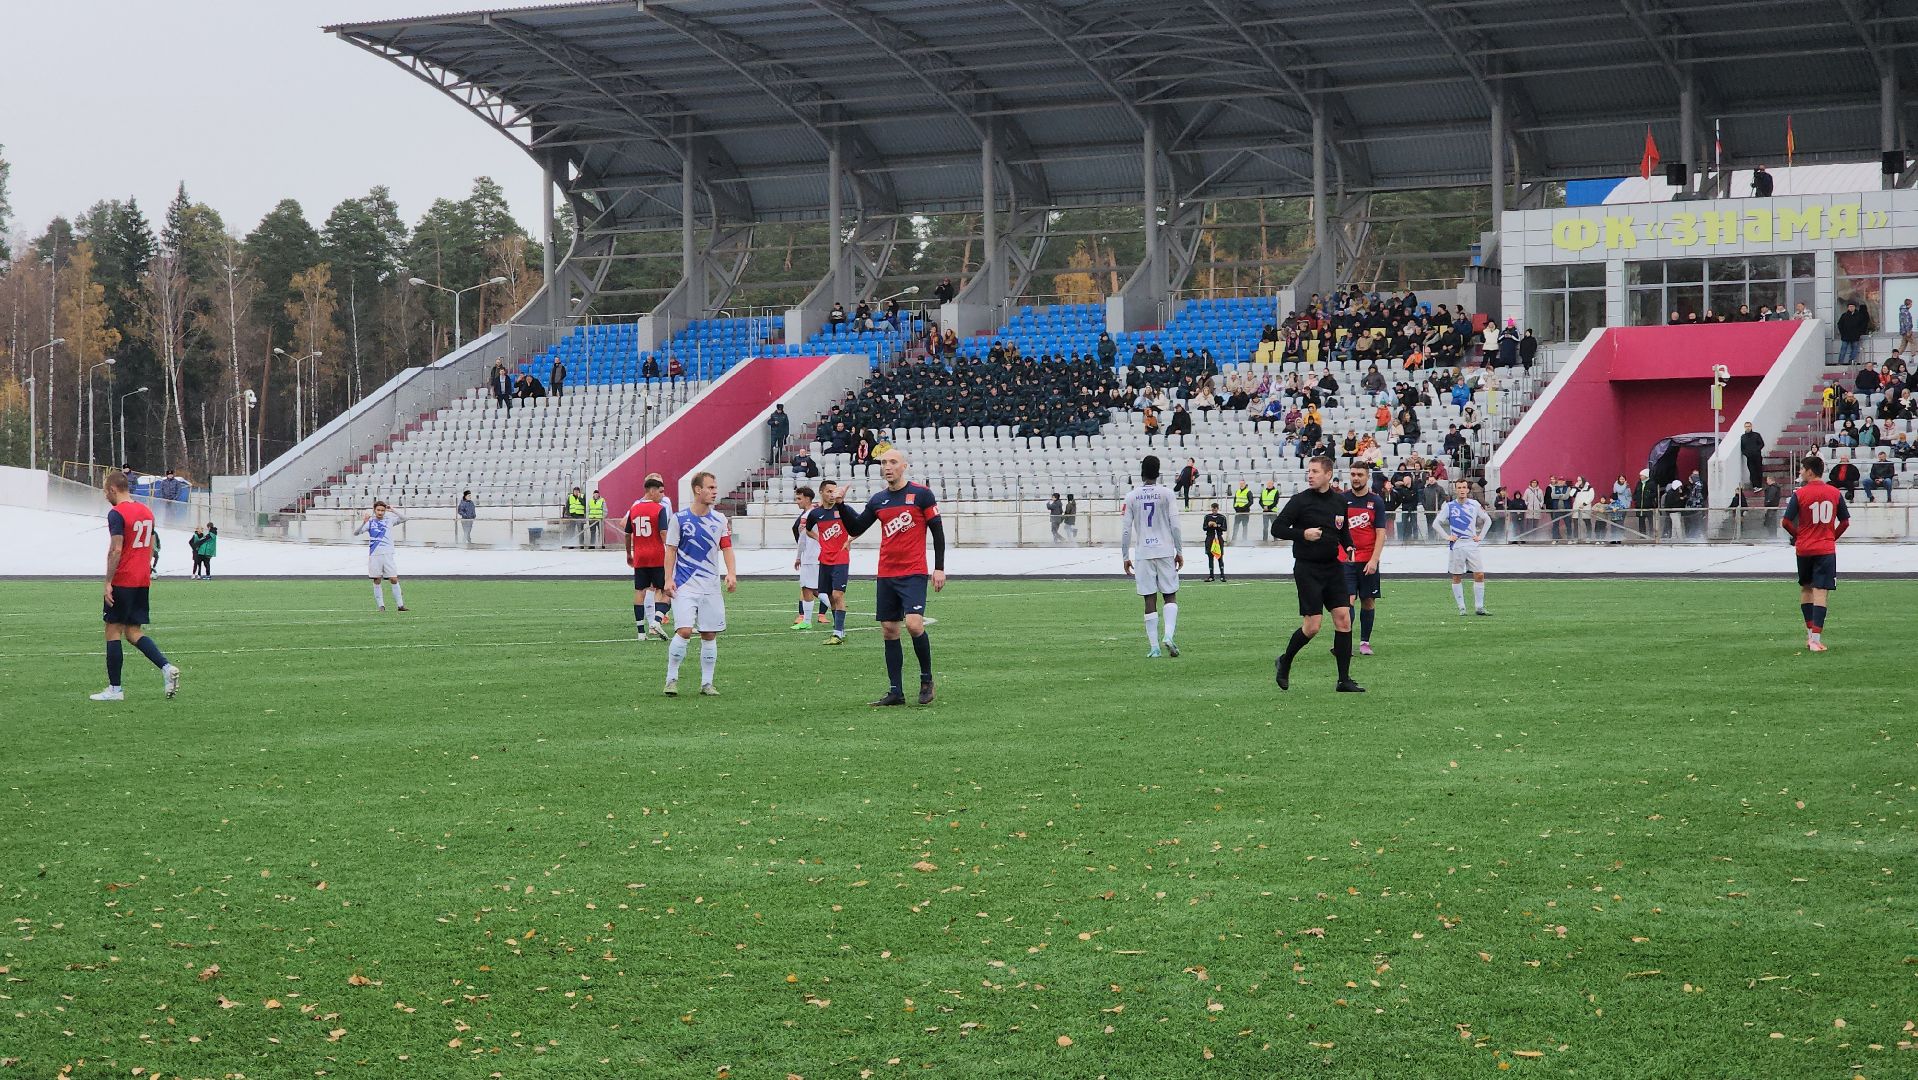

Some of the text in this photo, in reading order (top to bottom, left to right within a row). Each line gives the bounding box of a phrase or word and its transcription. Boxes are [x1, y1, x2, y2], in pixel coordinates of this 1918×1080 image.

[1552, 215, 1637, 251] ФК
[884, 511, 912, 537] LEBO
[1143, 502, 1155, 527] 7
[1809, 501, 1834, 524] 10
[132, 519, 153, 548] 27
[632, 516, 652, 537] 15
